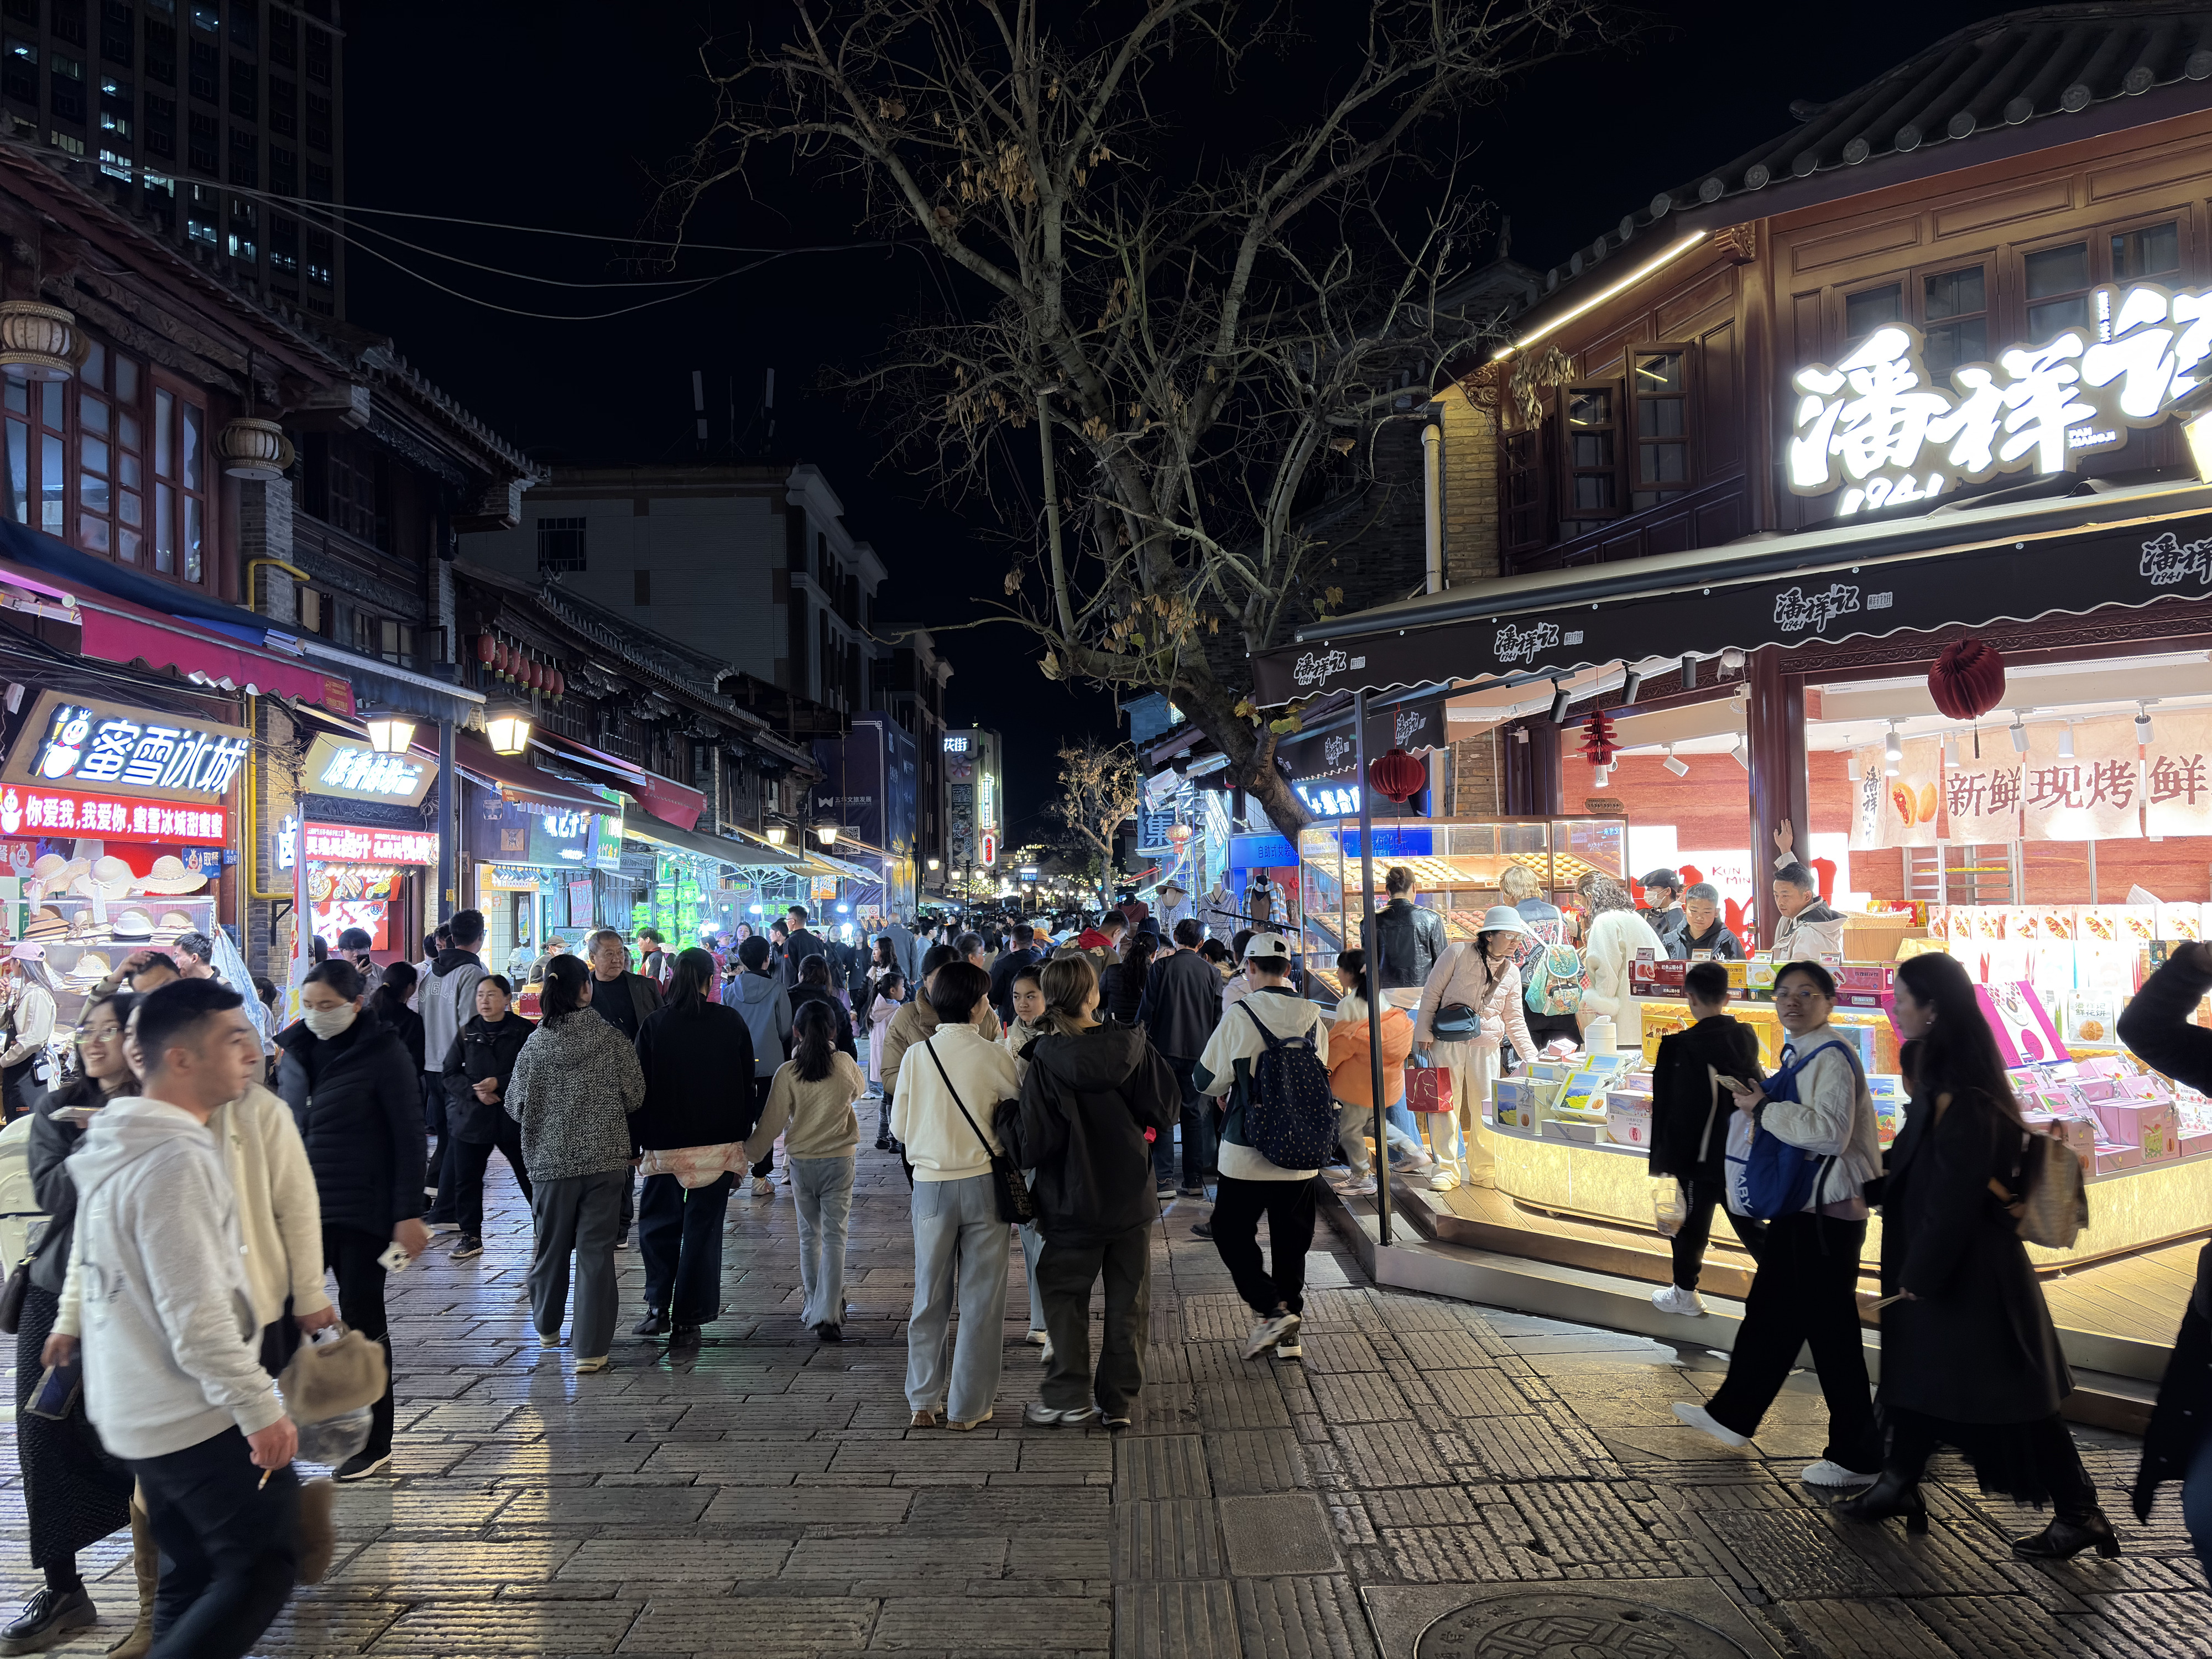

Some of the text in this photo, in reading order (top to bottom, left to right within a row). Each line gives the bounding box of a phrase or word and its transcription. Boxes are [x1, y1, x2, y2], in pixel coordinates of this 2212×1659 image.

[2068, 426, 2093, 440] PAN
[2068, 431, 2117, 449] XIANGJI
[1840, 473, 1945, 516] 1941
[2153, 571, 2182, 583] 1941
[1776, 585, 1892, 632] 潘祥记 鲜花饼
[1783, 620, 1804, 629] 1941
[1495, 625, 1558, 663] 潘祥记
[1295, 651, 1345, 686] 潘祥记
[1300, 676, 1312, 685] 1941
[944, 738, 967, 752] 花街
[76, 721, 249, 794] 蜜雪冰城
[1947, 754, 2210, 818] 新鲜 现烤 鲜
[203, 852, 219, 867] 取餐
[1712, 866, 1741, 876] KUN
[763, 904, 790, 916] 翡翠
[2075, 1008, 2106, 1016] 鲜花饼
